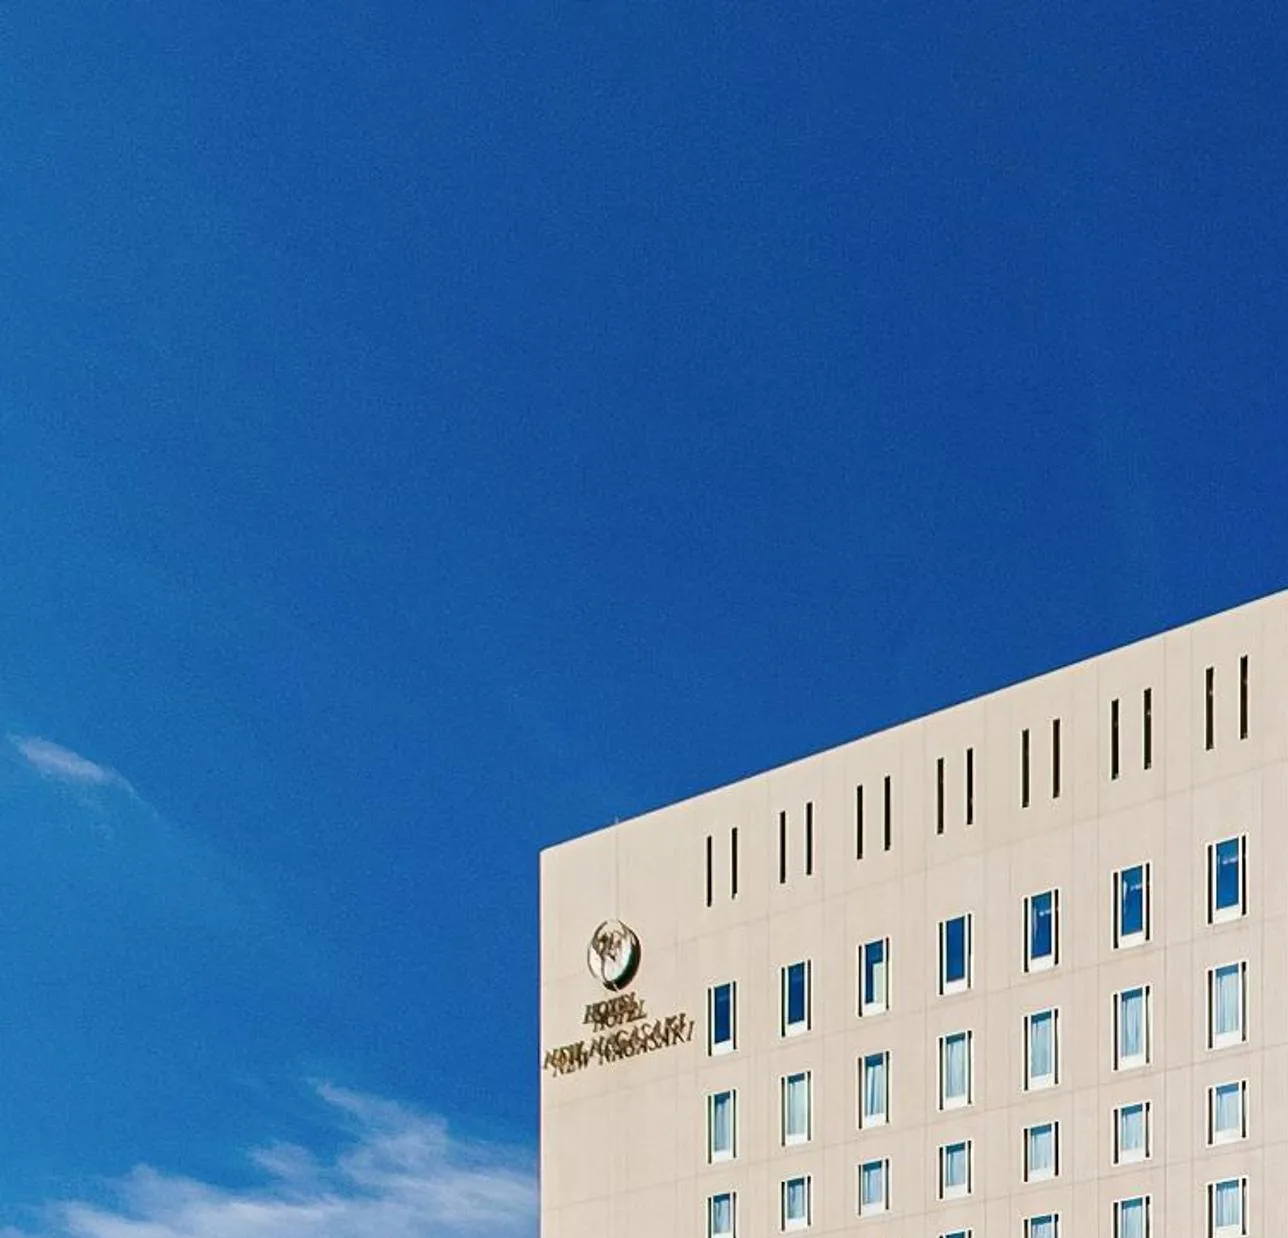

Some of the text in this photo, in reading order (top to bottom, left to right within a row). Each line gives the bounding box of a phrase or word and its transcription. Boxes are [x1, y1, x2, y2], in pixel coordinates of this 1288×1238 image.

[583, 992, 646, 1032] HOTEL
[543, 1012, 695, 1077] NEW NAGASAKI
